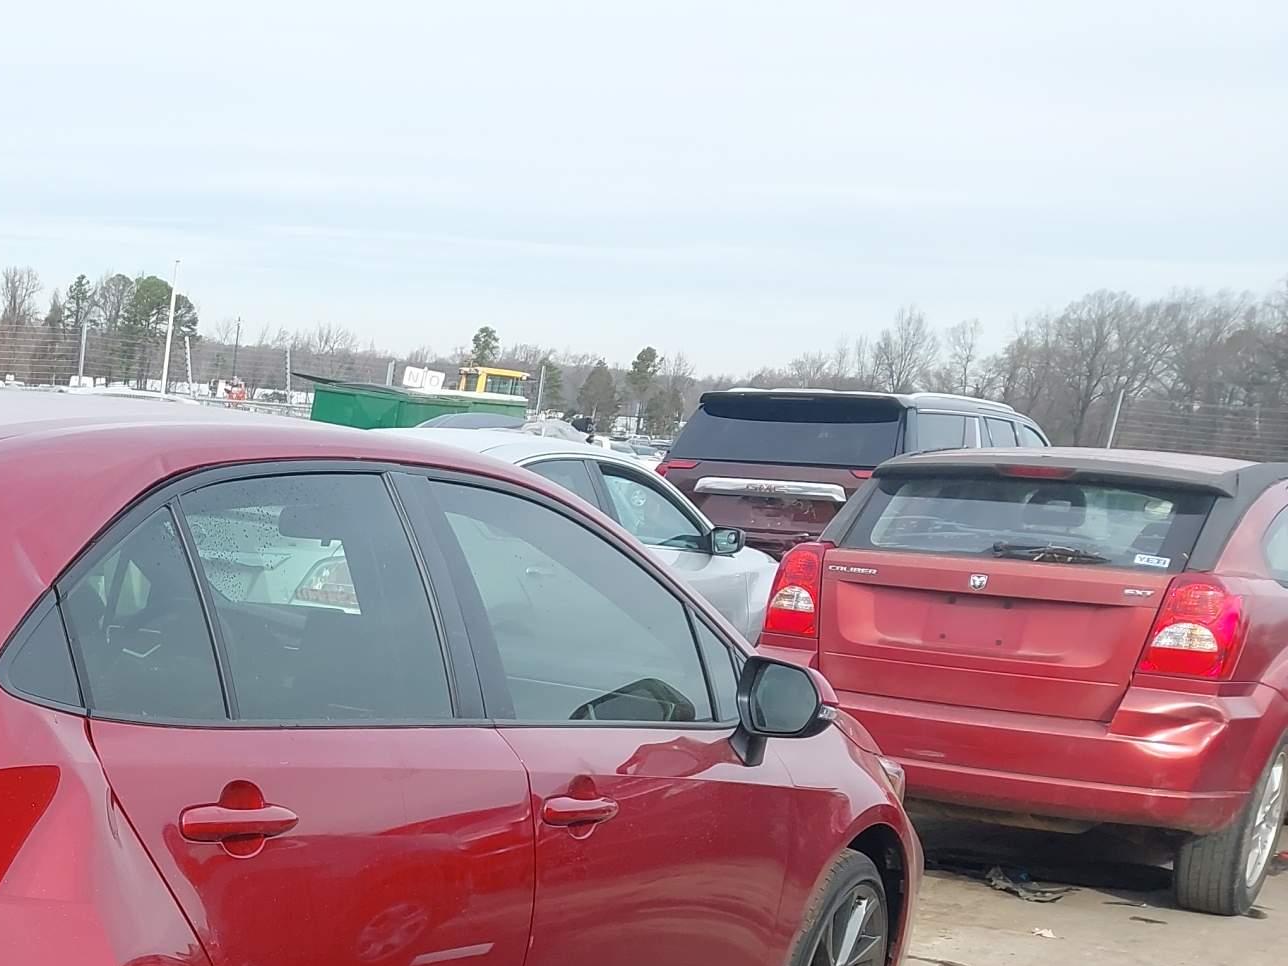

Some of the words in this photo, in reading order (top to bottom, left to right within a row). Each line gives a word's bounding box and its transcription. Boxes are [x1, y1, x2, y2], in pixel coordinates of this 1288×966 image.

[408, 369, 420, 383] N
[429, 375, 440, 387] O
[828, 564, 878, 575] CALIBER
